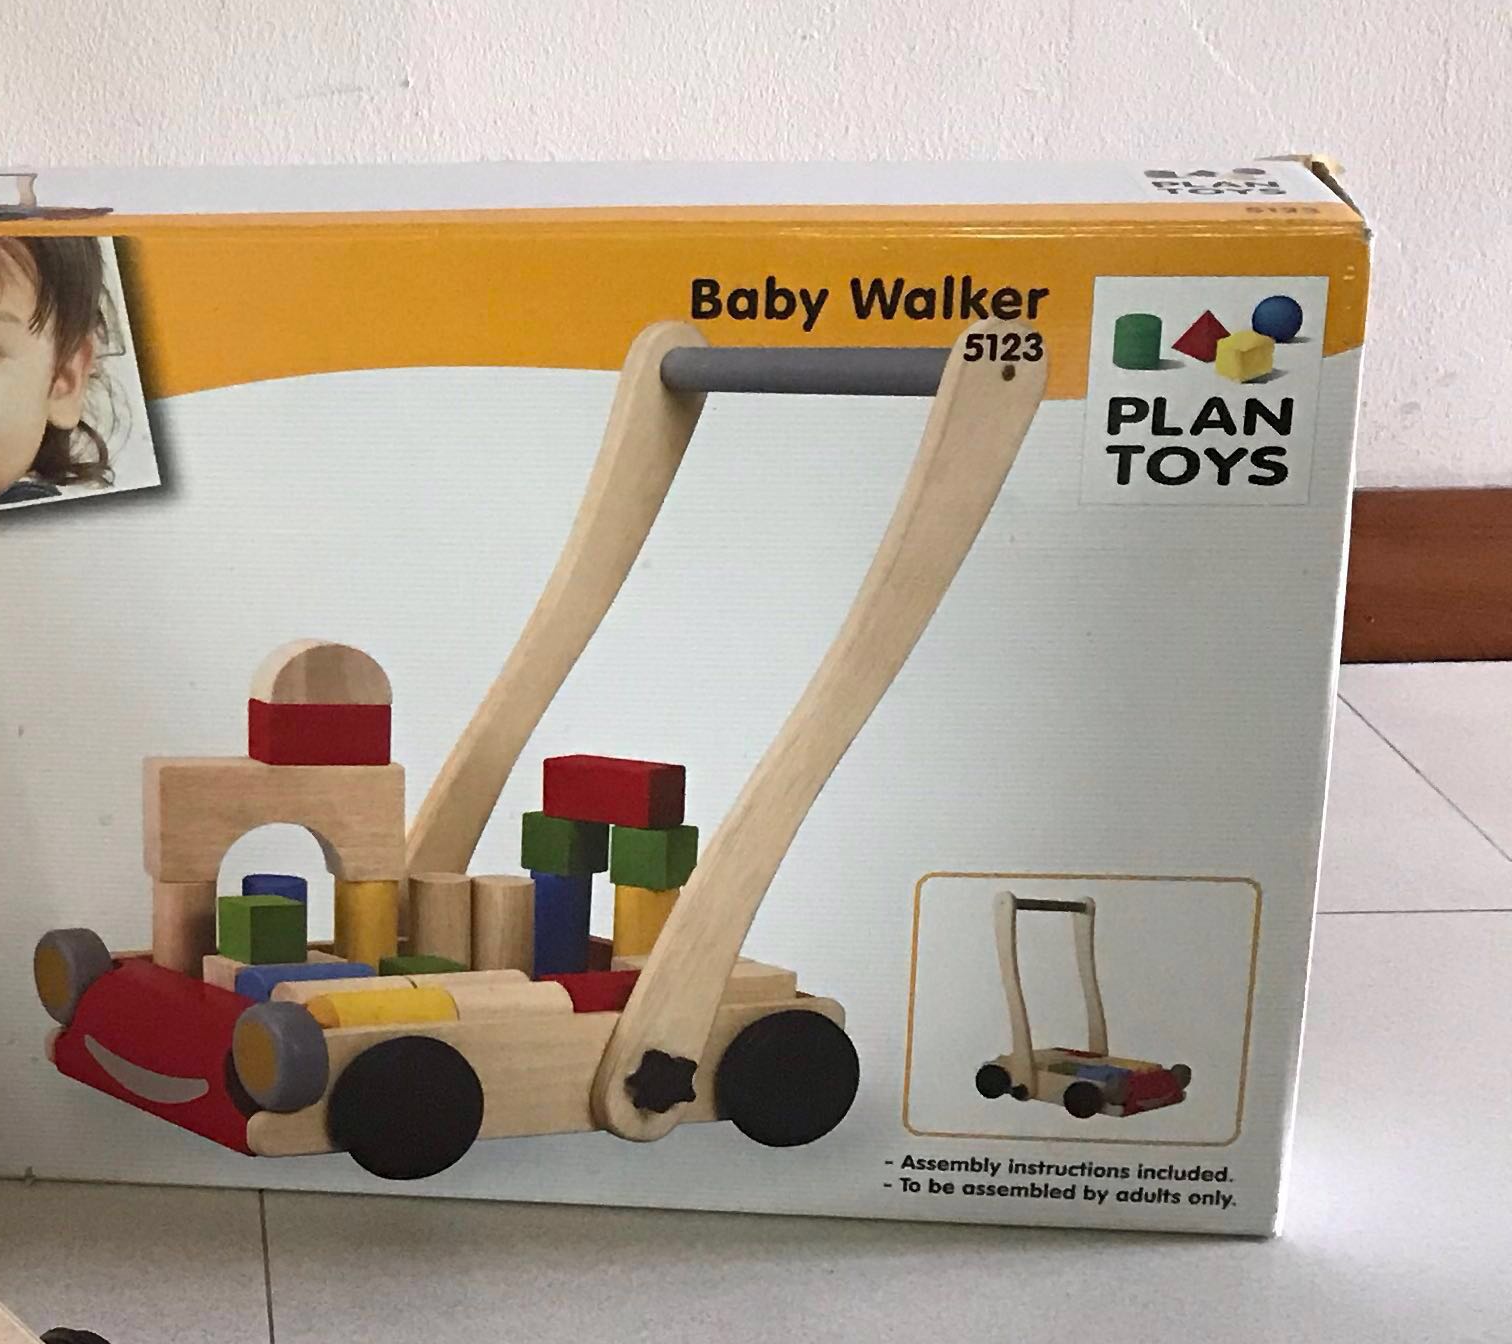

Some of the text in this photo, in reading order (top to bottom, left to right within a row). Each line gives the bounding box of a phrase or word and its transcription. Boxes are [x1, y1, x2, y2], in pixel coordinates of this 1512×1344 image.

[690, 275, 1050, 331] Baby Walker
[962, 332, 1044, 362] 5123
[1106, 397, 1295, 436] PLAN
[1105, 446, 1289, 487] TOYS
[900, 1155, 1002, 1176] Assembly
[1008, 1158, 1131, 1180] instructions
[1137, 1164, 1235, 1184] included.
[900, 1177, 922, 1195] To
[928, 1178, 955, 1197] be
[962, 1182, 1076, 1202] assembled
[1084, 1186, 1109, 1206] by
[1116, 1188, 1182, 1206] adults
[1188, 1192, 1238, 1210] only.
